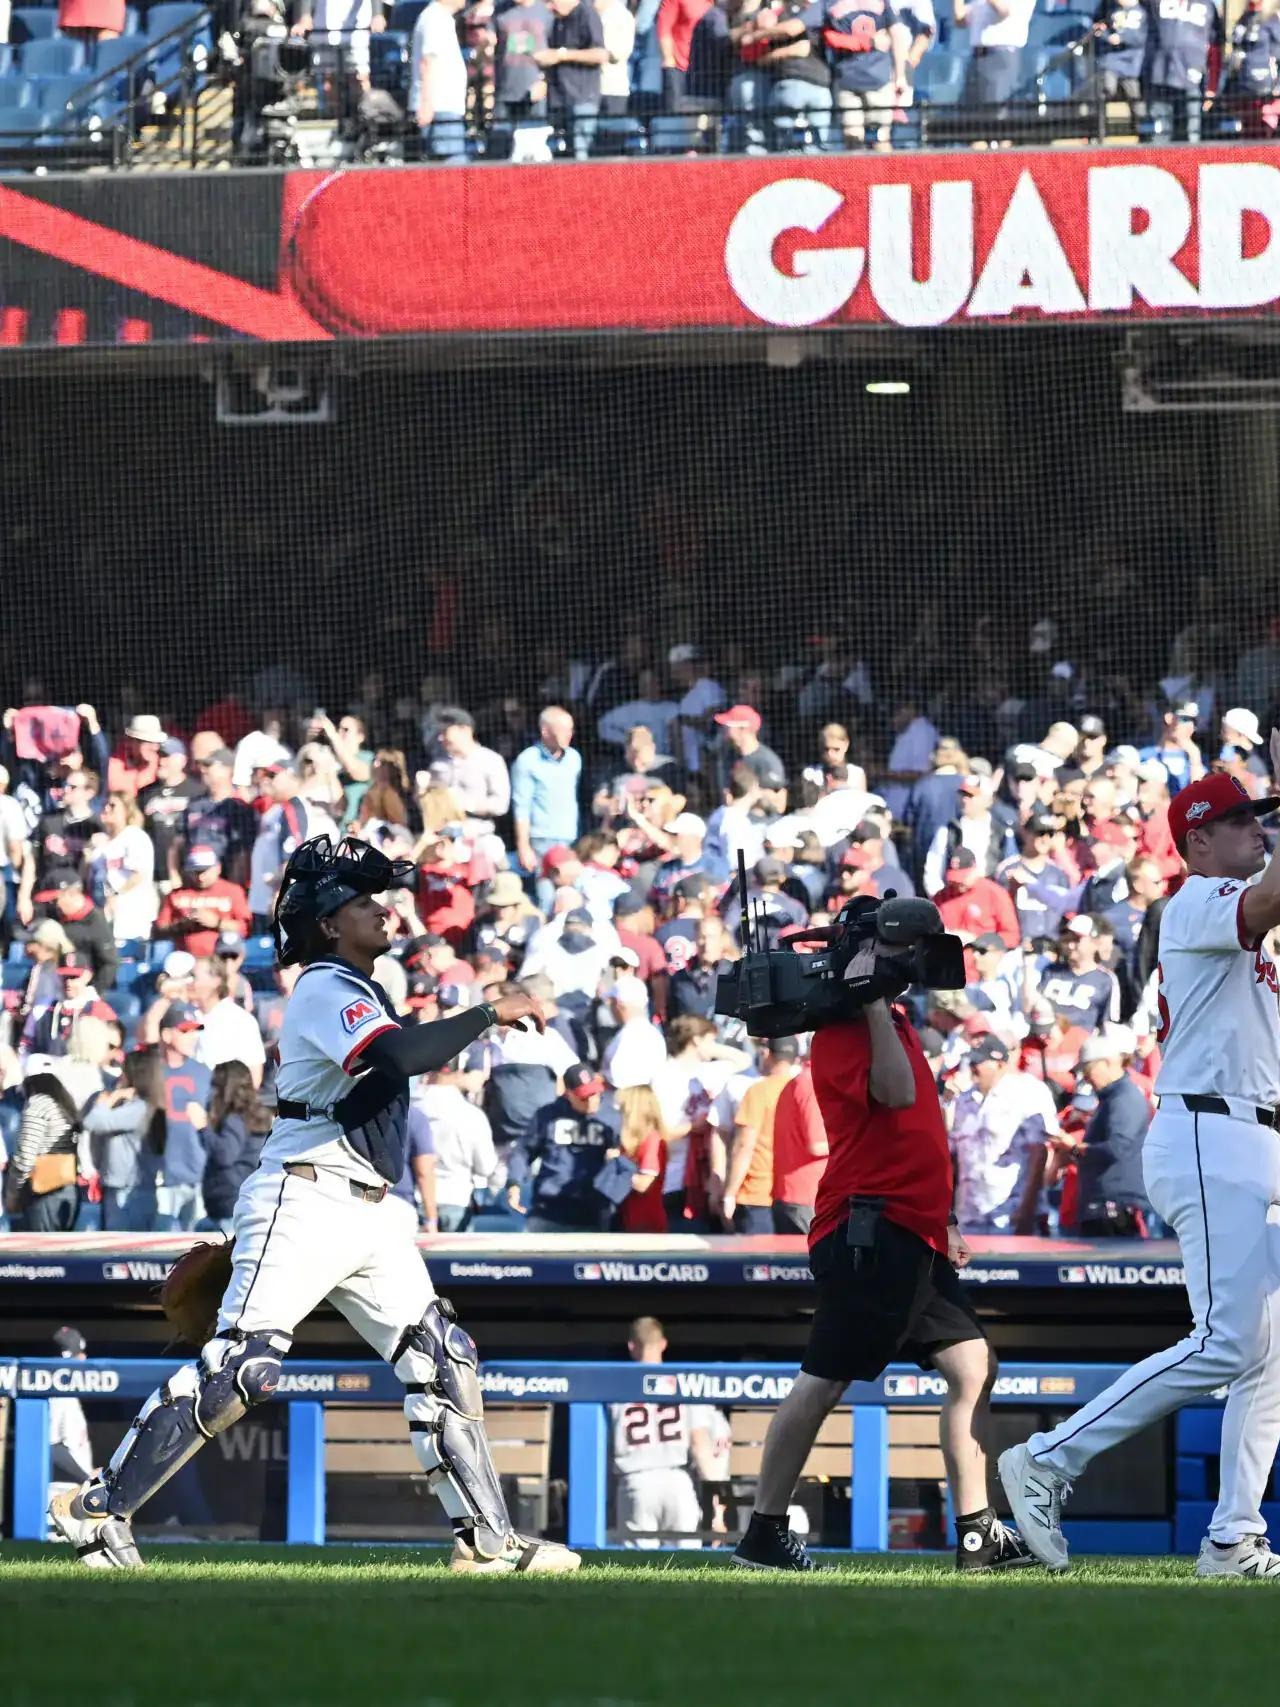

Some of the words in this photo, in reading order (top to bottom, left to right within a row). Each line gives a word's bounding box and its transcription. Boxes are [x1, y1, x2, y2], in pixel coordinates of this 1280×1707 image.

[451, 1263, 532, 1279] Booking.com
[955, 1266, 1019, 1283] king.com
[624, 1403, 682, 1446] 22
